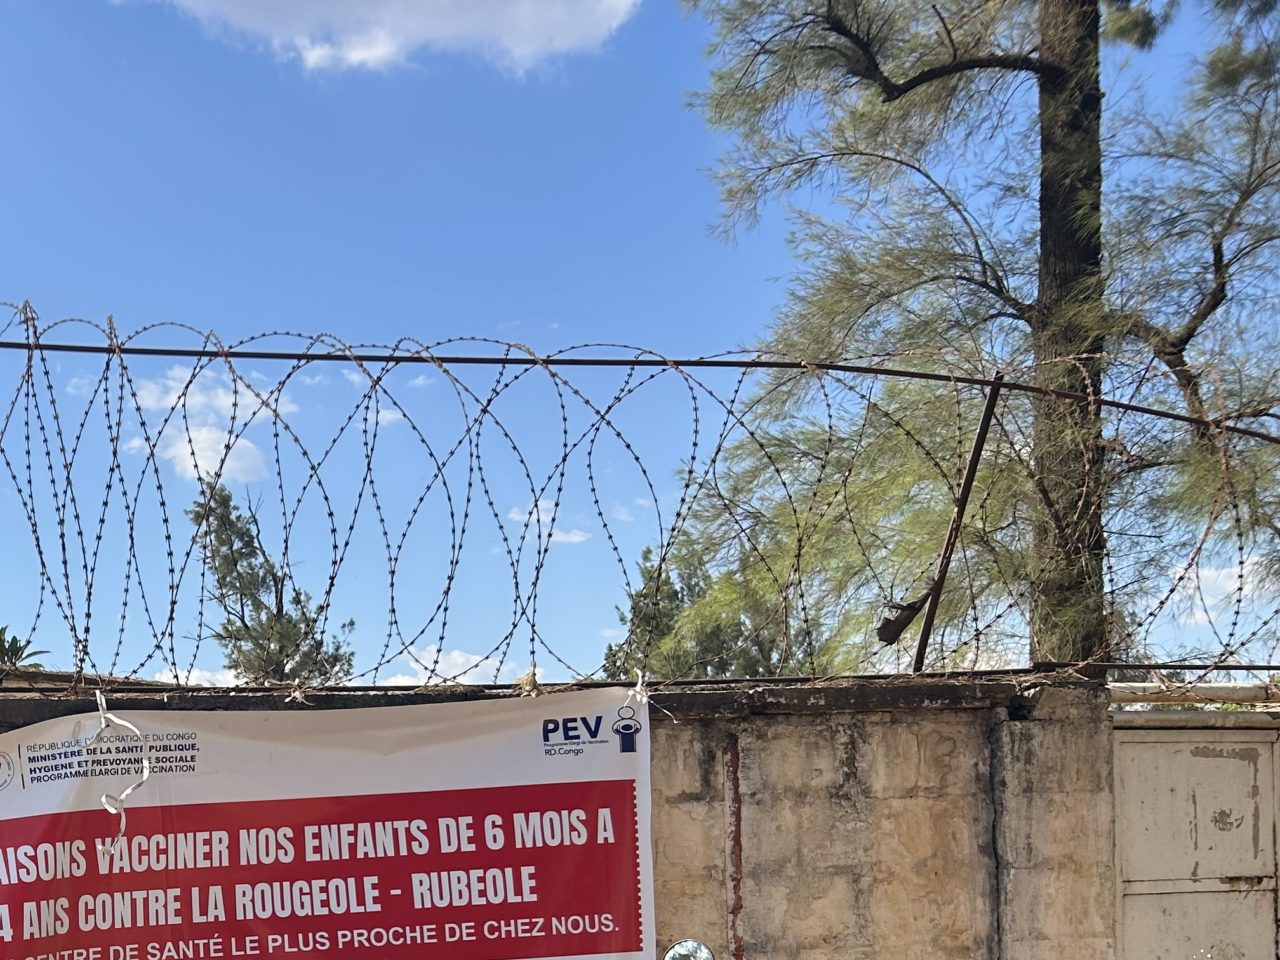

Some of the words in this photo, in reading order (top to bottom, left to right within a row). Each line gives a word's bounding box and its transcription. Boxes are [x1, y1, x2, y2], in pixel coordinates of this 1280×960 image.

[542, 715, 603, 743] PEV
[26, 739, 81, 753] RÉPUBLIQUE
[152, 733, 164, 742] DU
[166, 732, 197, 741] CONGO
[27, 749, 84, 764] MINISTÈRE
[86, 747, 98, 756] DE
[100, 746, 112, 755] LA
[148, 742, 200, 753] PUBLIQUE,
[29, 761, 75, 775] HYGIENE
[77, 760, 90, 768] ET
[154, 754, 197, 764] SOCIALE
[30, 769, 89, 784] PROGRAMME
[90, 767, 119, 777] ELARGI
[120, 767, 132, 776] DE
[133, 764, 196, 775] VACINATION
[95, 831, 229, 875] VACCINER
[239, 826, 295, 866] NOS
[304, 819, 429, 862] ENFANTS
[437, 815, 476, 854] DE
[483, 813, 505, 851] 6
[512, 808, 588, 849] MOIS
[596, 807, 616, 844] A
[22, 897, 70, 941] ANS
[78, 887, 183, 932] CONTRE
[191, 885, 226, 924] LA
[234, 875, 382, 921] ROUGEOLE
[411, 865, 538, 909] RUBEOLE
[231, 935, 261, 957] LE
[267, 931, 331, 954] PLUS
[337, 924, 438, 949] PROCHE
[444, 921, 477, 943] DE
[483, 917, 546, 940] CHEZ
[551, 913, 620, 936] NOUS.
